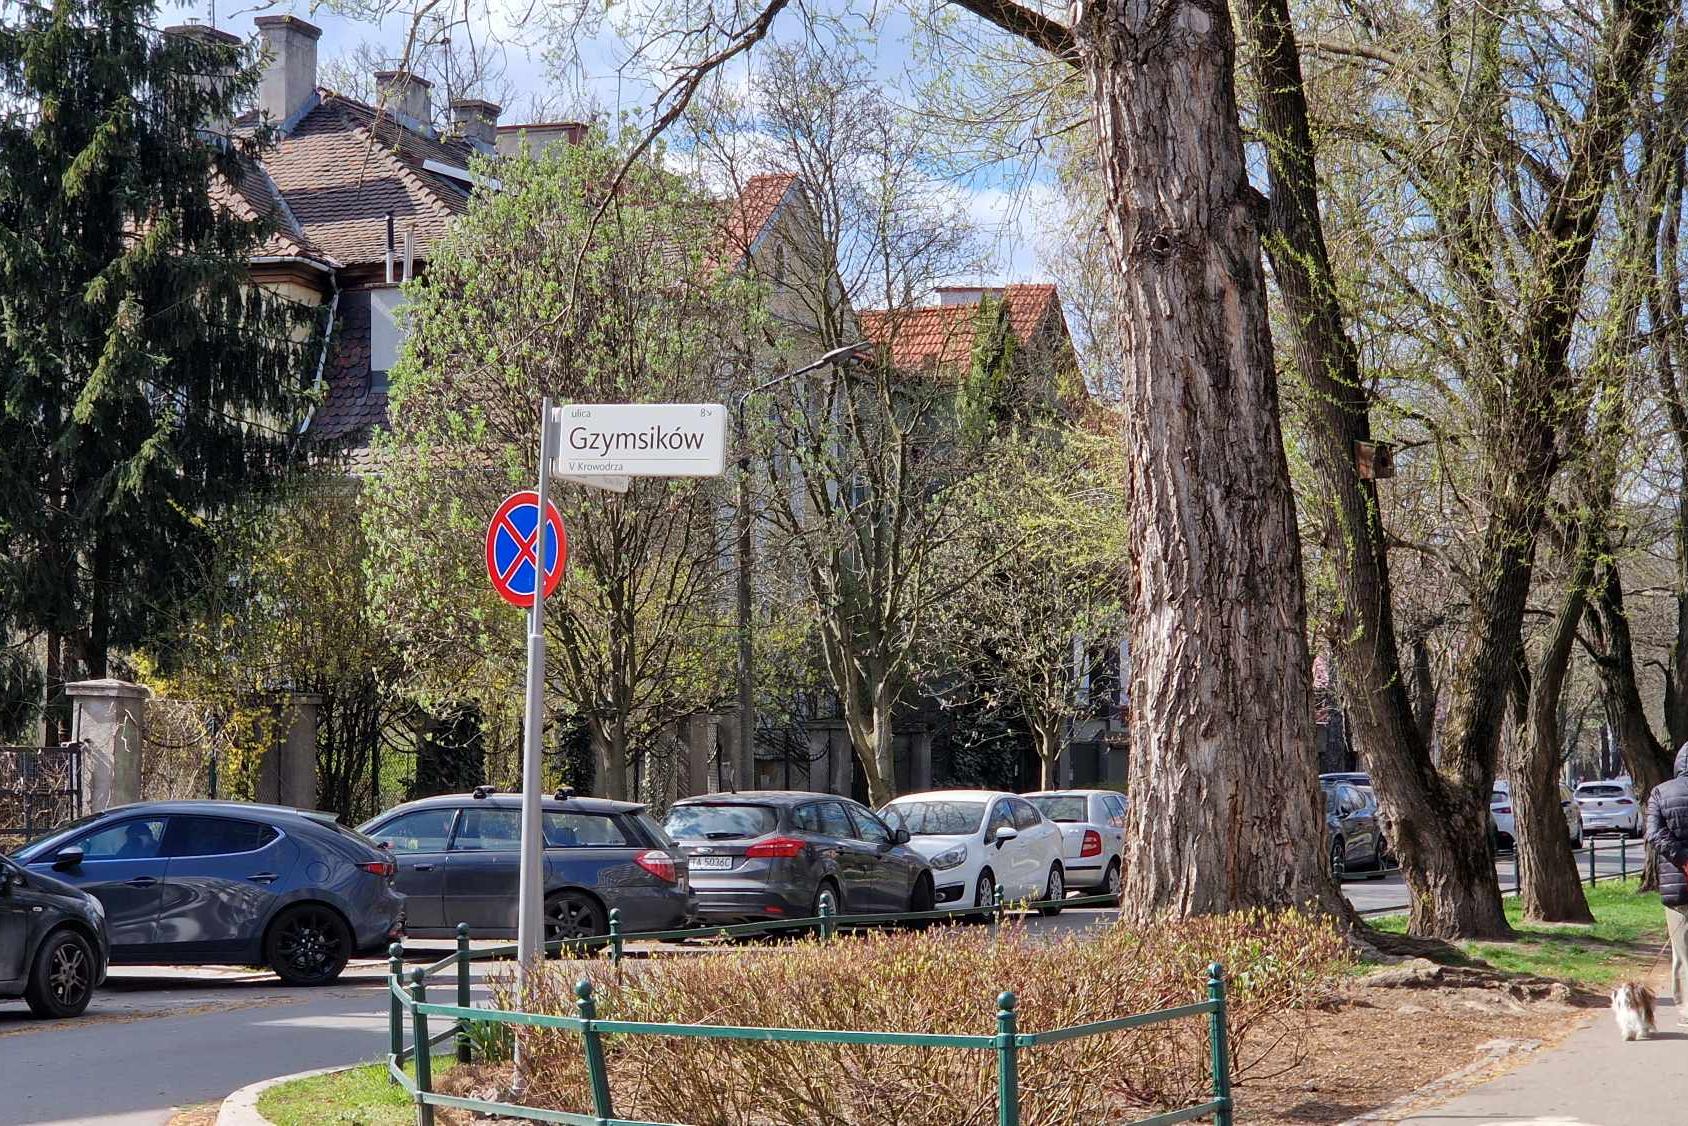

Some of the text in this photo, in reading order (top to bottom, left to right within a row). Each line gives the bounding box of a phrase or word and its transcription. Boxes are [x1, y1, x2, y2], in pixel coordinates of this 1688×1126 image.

[571, 408, 591, 418] ulica
[700, 407, 706, 417] 8
[569, 425, 704, 457] Gzymsików
[568, 461, 623, 471] V Krowodrza
